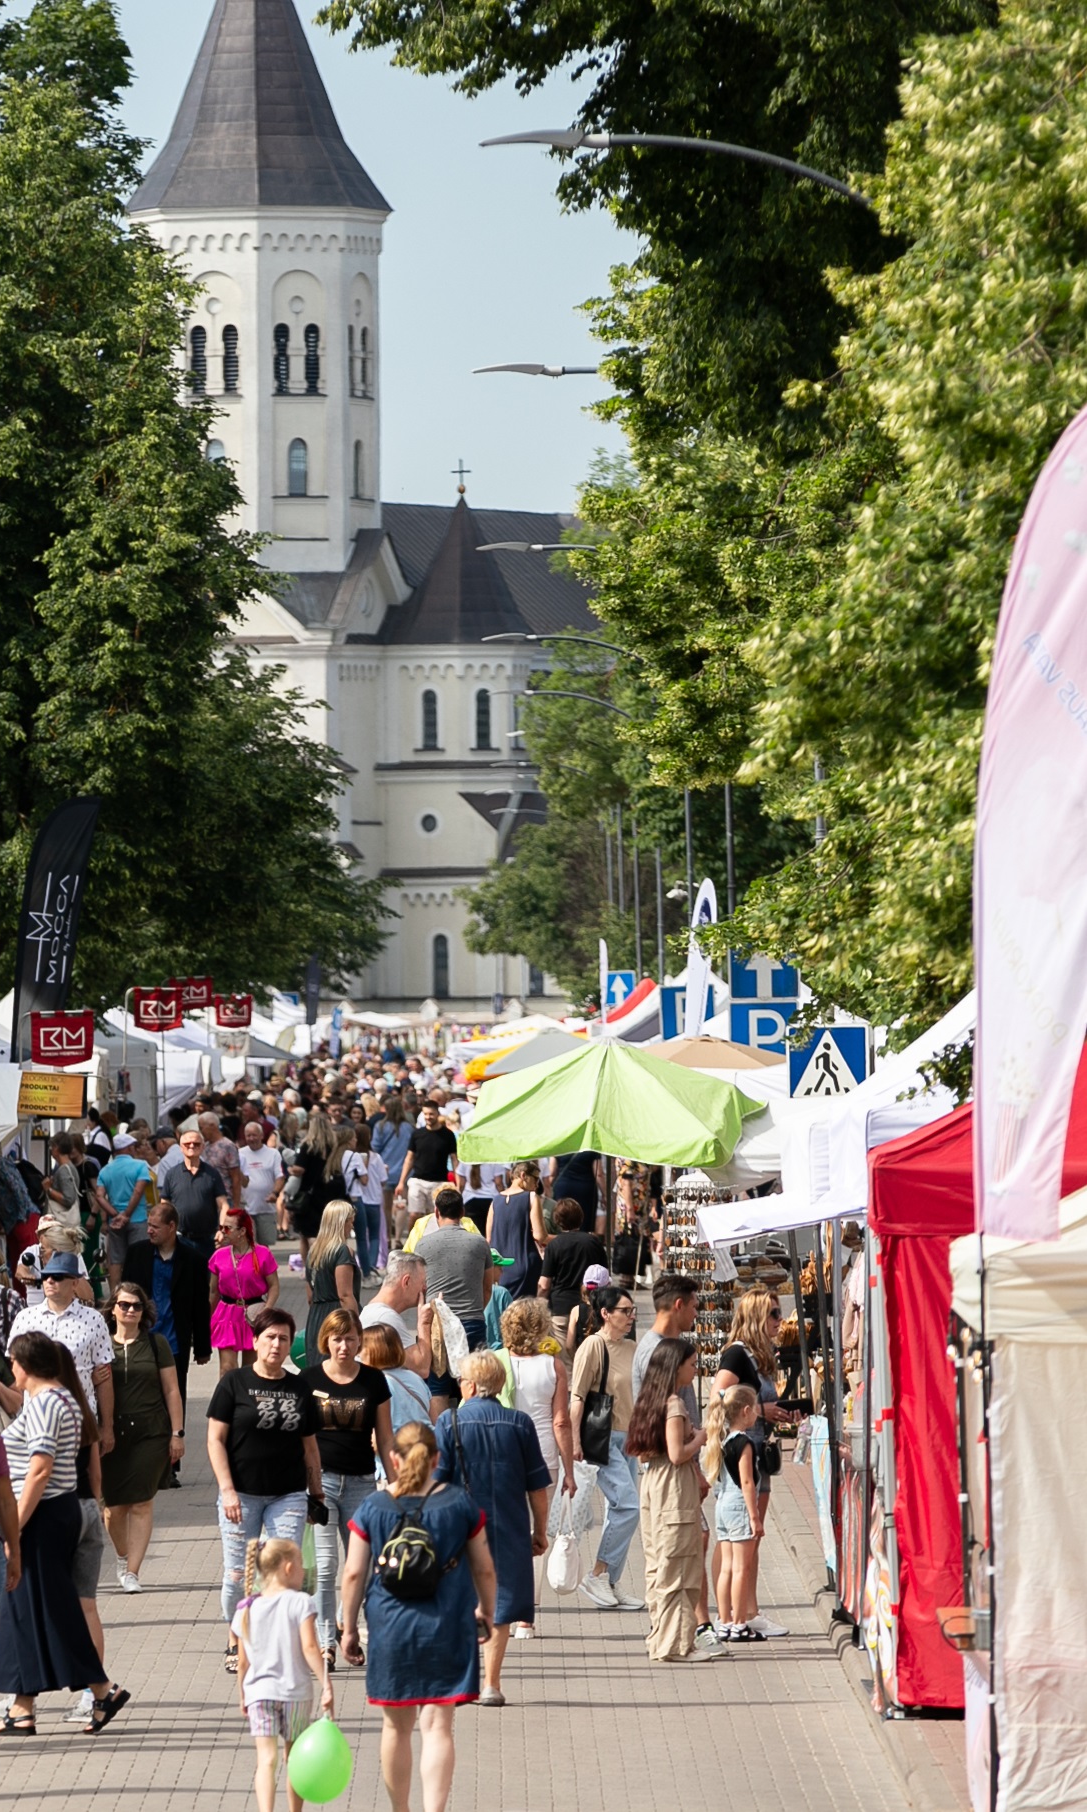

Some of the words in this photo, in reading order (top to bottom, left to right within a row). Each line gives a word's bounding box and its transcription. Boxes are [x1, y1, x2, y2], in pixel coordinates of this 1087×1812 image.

[748, 1009, 786, 1048] P
[40, 1026, 85, 1050] KM
[20, 1083, 59, 1091] PRODUKTAI
[20, 1103, 57, 1111] PRODUCTS
